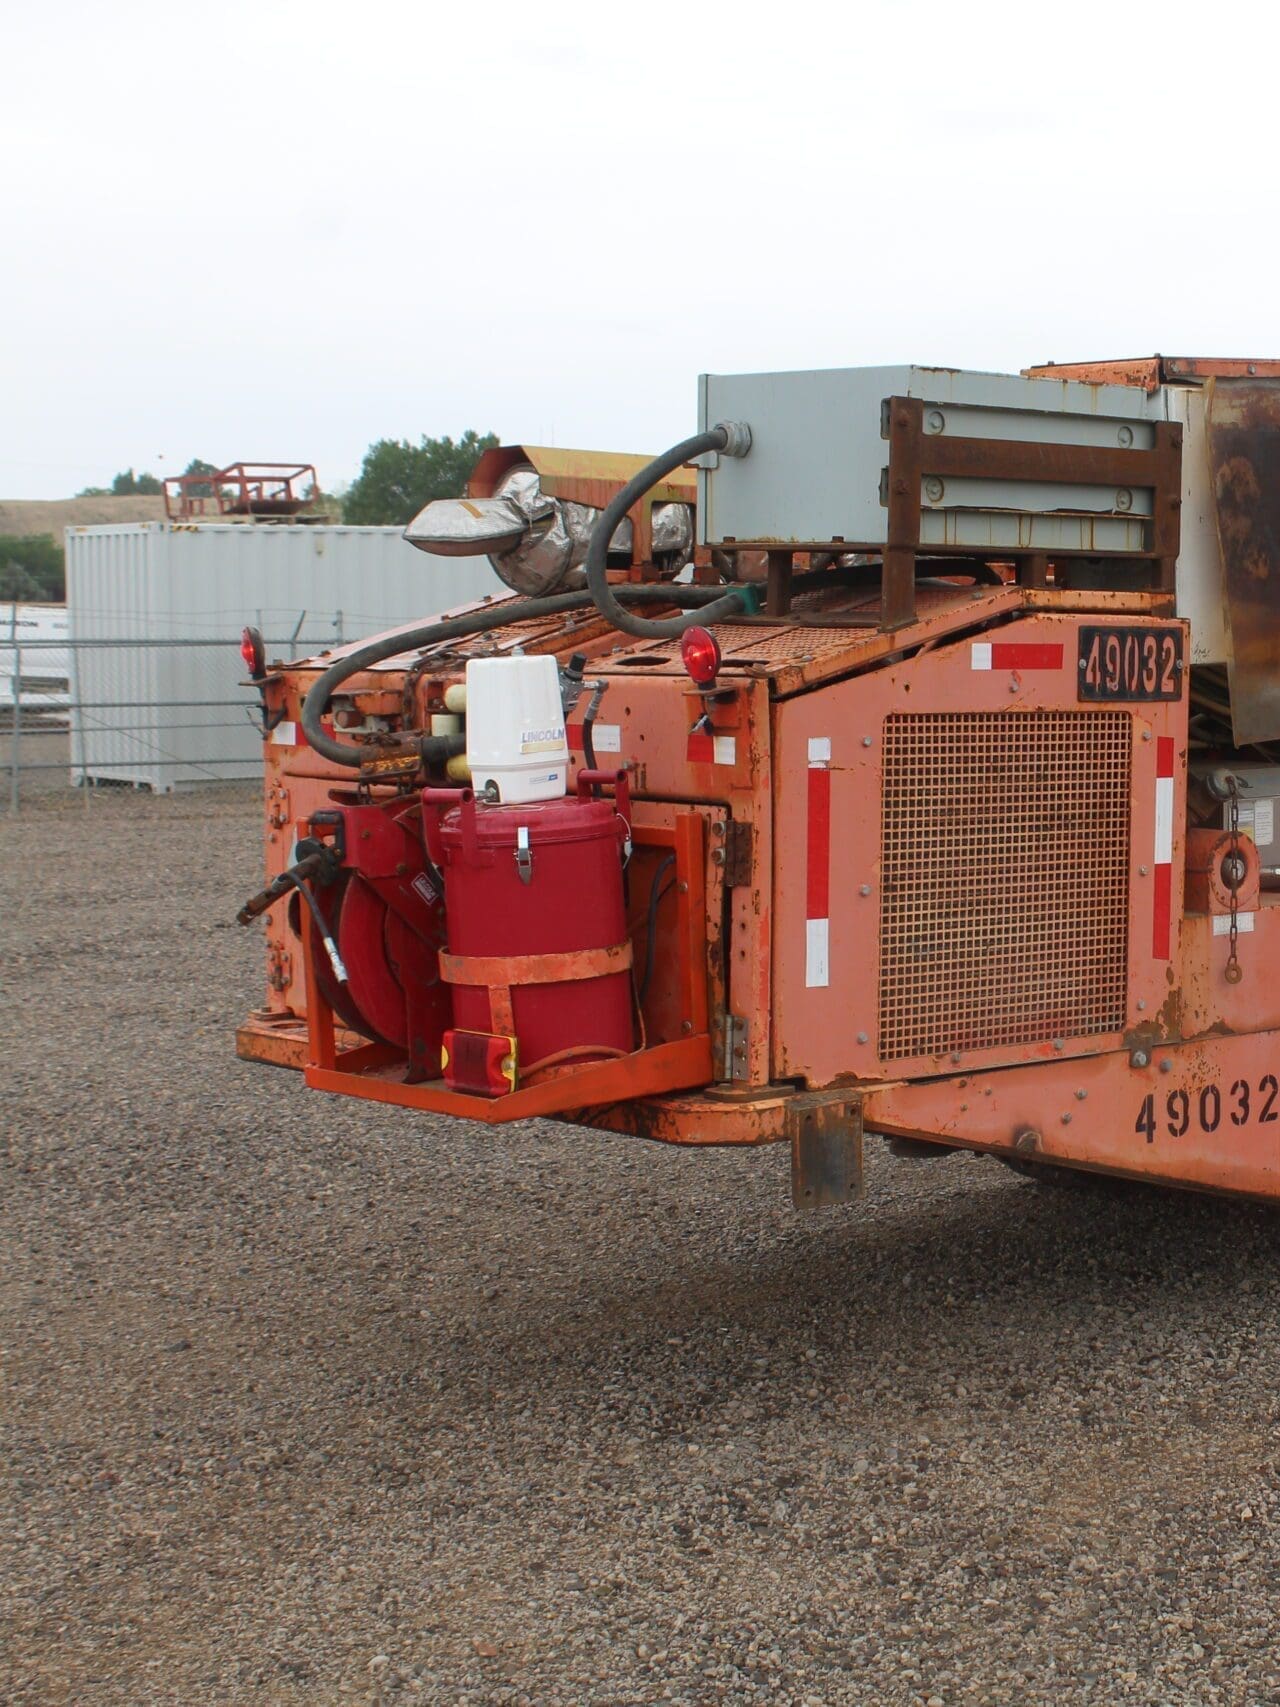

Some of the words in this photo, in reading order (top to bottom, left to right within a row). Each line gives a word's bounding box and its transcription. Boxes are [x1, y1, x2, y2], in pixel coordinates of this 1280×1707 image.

[1085, 632, 1176, 694] 49032
[521, 728, 565, 743] LINCOLN
[1135, 1074, 1279, 1143] 49032
